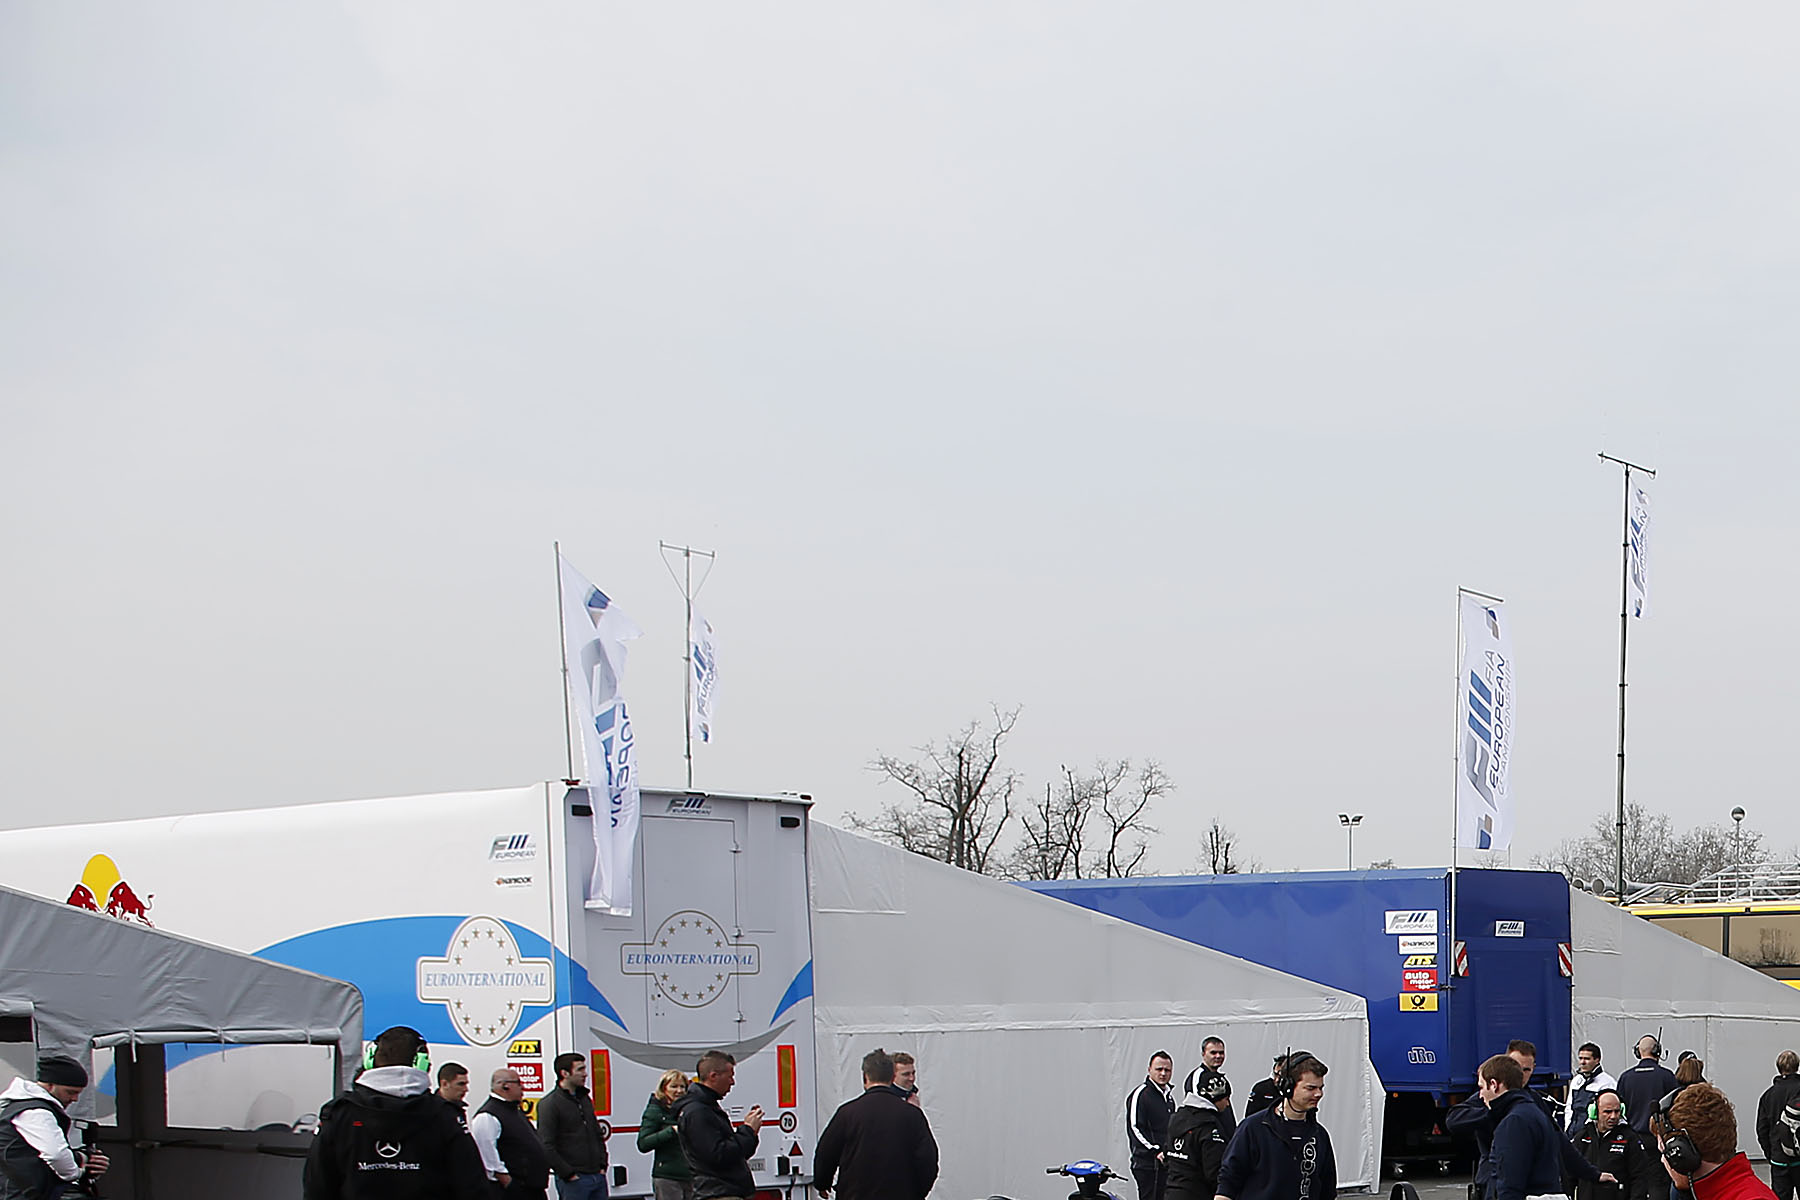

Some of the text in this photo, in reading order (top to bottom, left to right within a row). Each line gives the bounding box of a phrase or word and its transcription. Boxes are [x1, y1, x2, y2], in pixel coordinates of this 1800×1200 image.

[1484, 650, 1495, 685] FIA
[1489, 652, 1505, 789] EUROPEAN
[493, 850, 537, 860] EUROPEAN
[1395, 922, 1435, 930] EUROPEAN
[626, 953, 755, 967] EUROINTERNATIONAL
[425, 972, 547, 988] EUROINTERNATIONAL
[1404, 971, 1430, 981] auto
[357, 1161, 421, 1171] Mercedes-Benz
